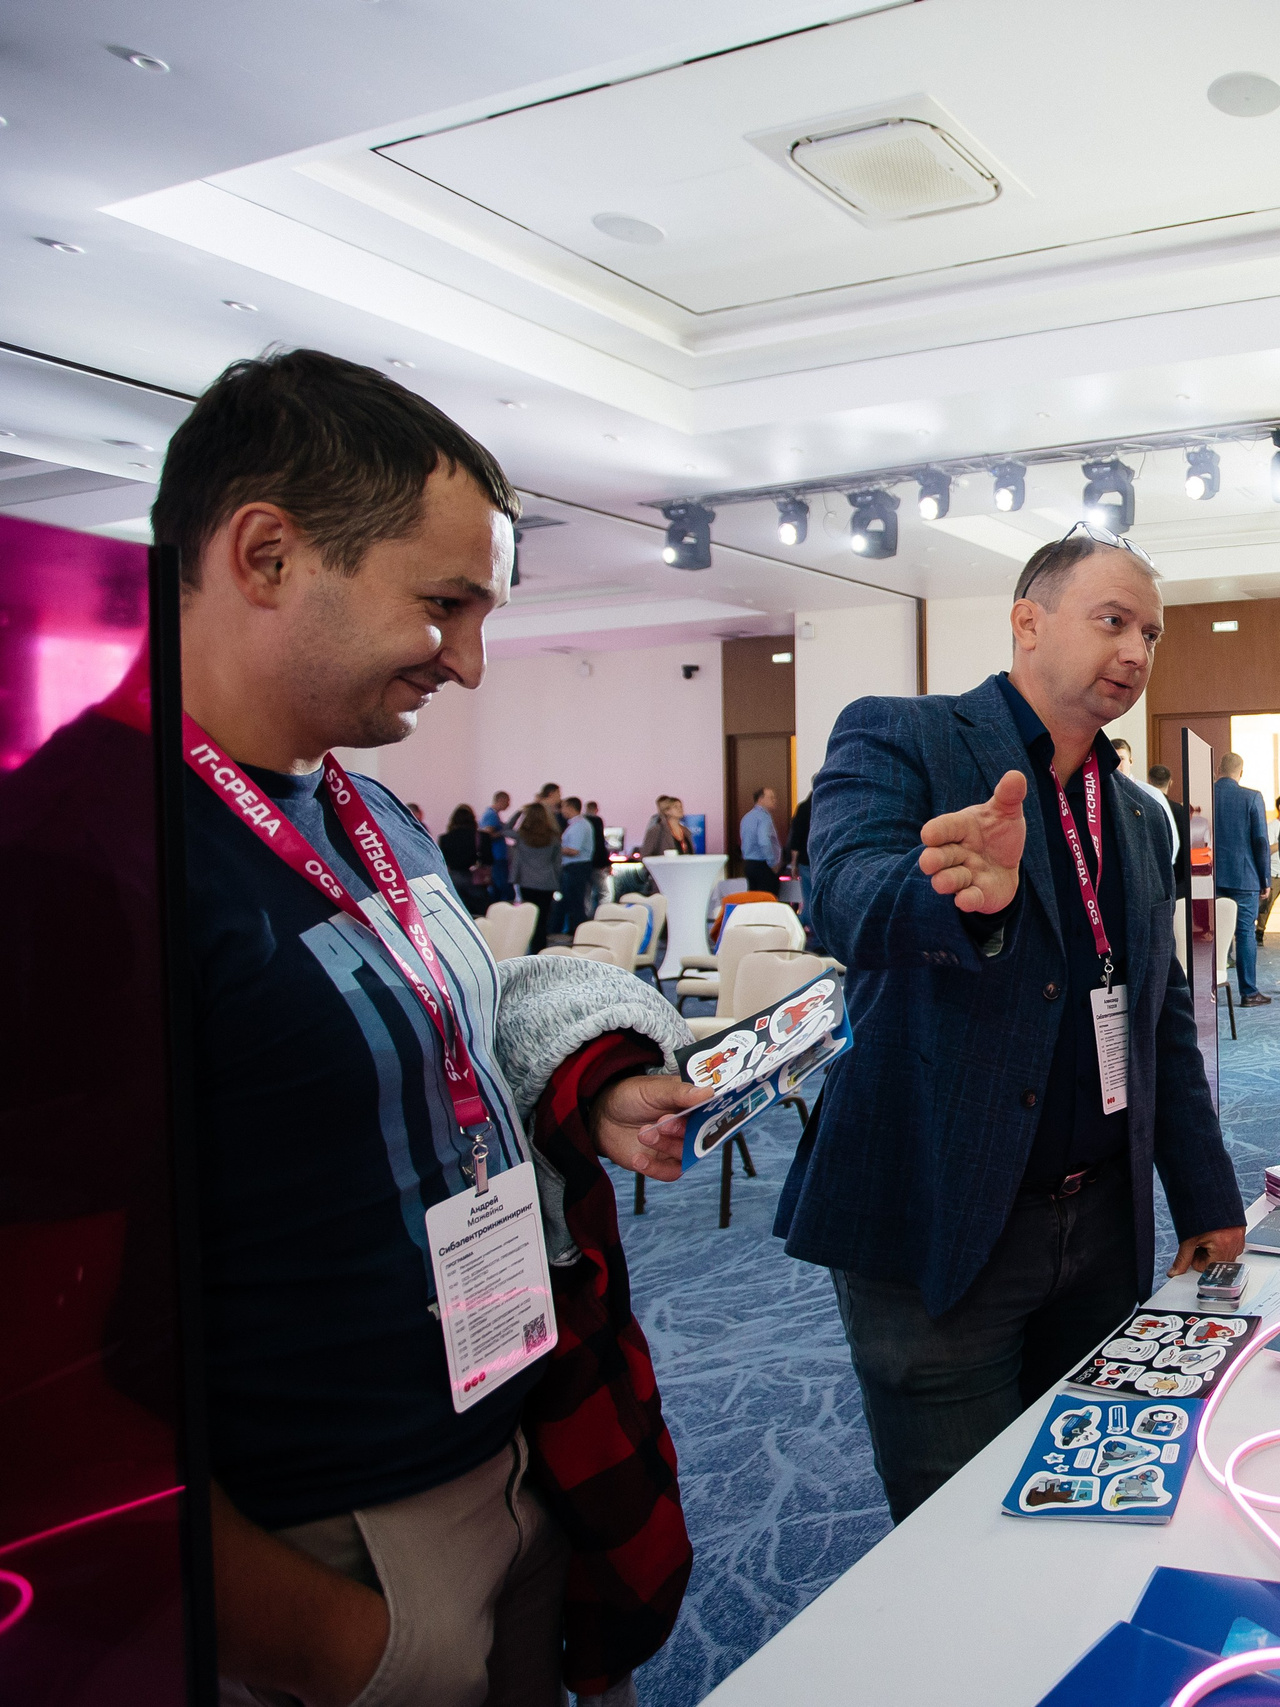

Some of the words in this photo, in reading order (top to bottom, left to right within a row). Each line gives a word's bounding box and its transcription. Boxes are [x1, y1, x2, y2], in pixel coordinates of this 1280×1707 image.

[190, 743, 281, 837] IT-СРЕДА
[326, 768, 351, 806] OCS
[1058, 791, 1069, 817] OCS
[1084, 771, 1097, 824] IT-СРЕДА
[354, 820, 409, 904] IT-СРЕДА
[1066, 828, 1088, 887] IT-СРЕДА
[305, 859, 344, 899] OCS
[1087, 899, 1100, 926] OCS
[409, 923, 434, 962] OCS
[469, 1196, 499, 1217] Андрей
